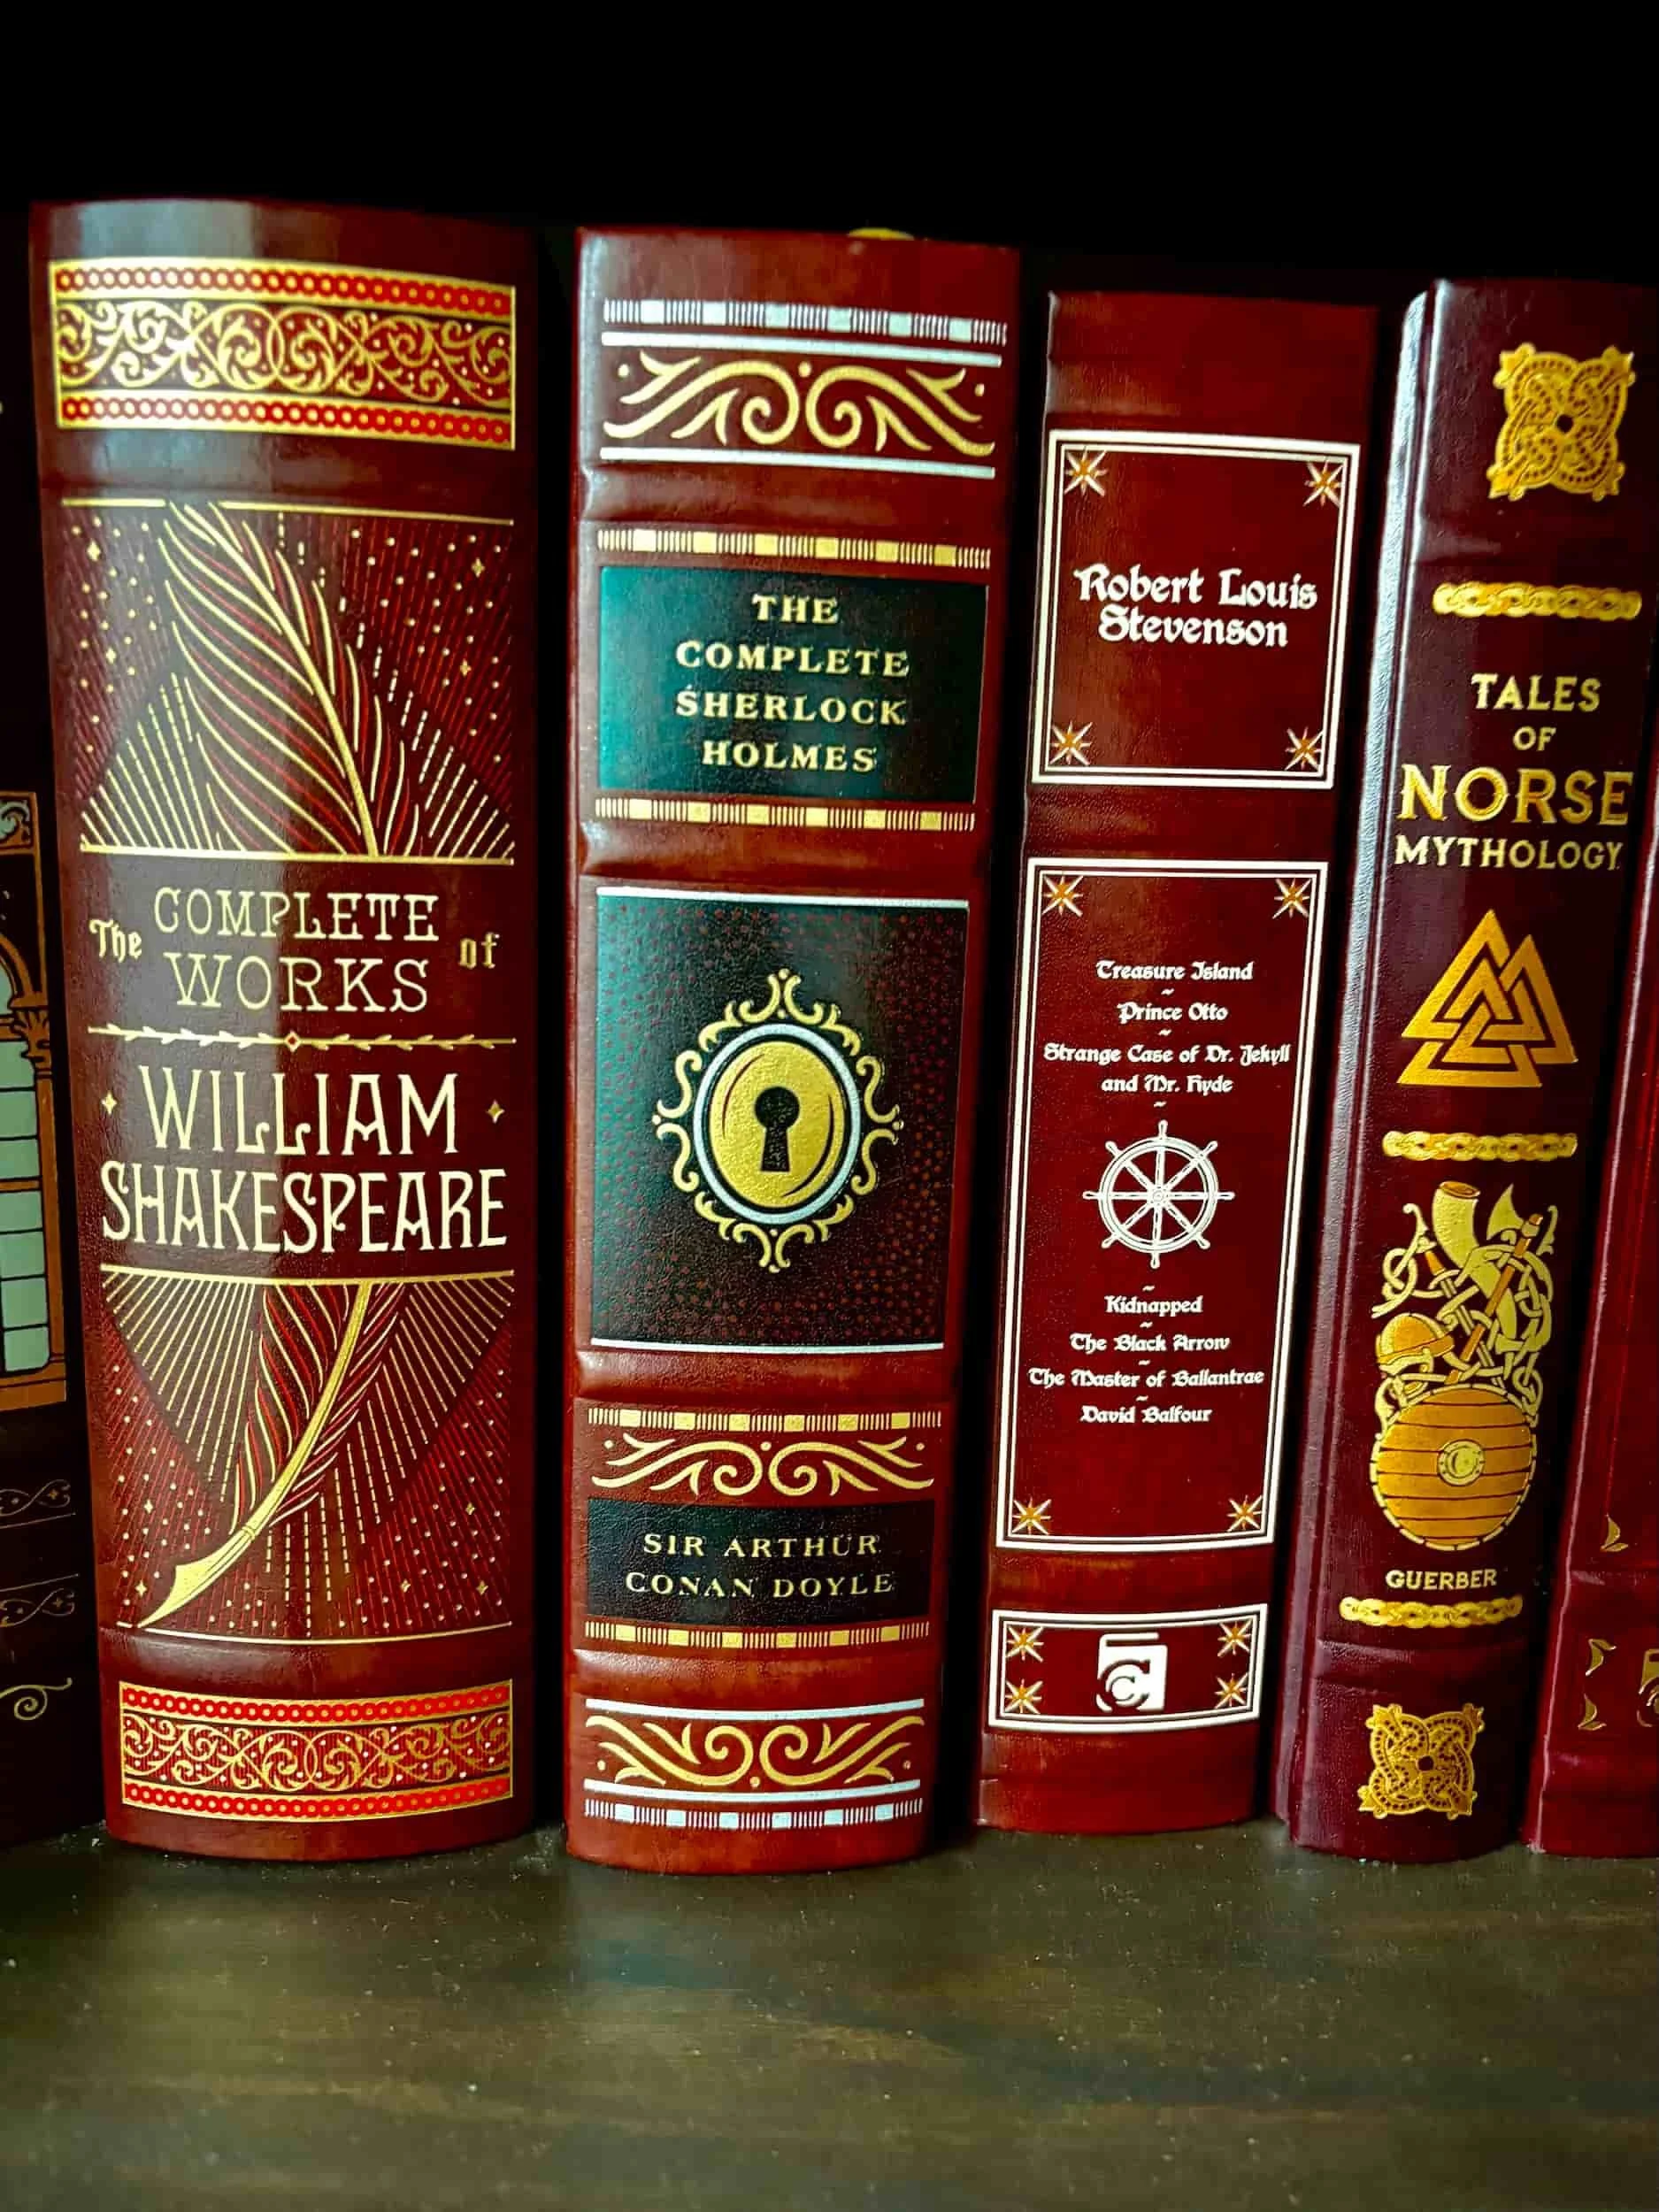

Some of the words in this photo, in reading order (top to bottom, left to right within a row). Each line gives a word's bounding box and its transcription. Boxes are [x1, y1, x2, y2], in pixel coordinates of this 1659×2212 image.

[1073, 563, 1204, 604] Robert
[1218, 568, 1317, 610] Louis
[751, 594, 840, 624] THE
[1098, 603, 1288, 648] Stevenson
[675, 640, 910, 678] COMPLETE
[675, 689, 908, 726] SHERLOCK
[1471, 672, 1601, 712] TALES
[1513, 726, 1557, 751] OF
[702, 740, 879, 773] HOLMES
[1396, 764, 1634, 826] NORSE
[1394, 835, 1624, 871] MYTHOLOGY
[154, 887, 440, 941] COMPLETE
[89, 919, 142, 963] The
[459, 933, 500, 969] of
[163, 952, 429, 1013] WORKS
[1095, 960, 1185, 979] Treasure
[1190, 961, 1255, 980] Island
[1117, 1002, 1183, 1024] Prince
[1187, 1002, 1229, 1021] Otto
[1043, 1042, 1122, 1065] Strange
[1126, 1044, 1174, 1063] Case
[1179, 1045, 1200, 1063] of
[1204, 1045, 1234, 1063] Dr.
[1239, 1044, 1292, 1066] Jekyll
[1101, 1074, 1139, 1093] and
[1144, 1075, 1180, 1093] Mr.
[1186, 1074, 1234, 1096] Hyde
[139, 1065, 458, 1156] WILLIAM
[100, 1160, 507, 1254] SHAKESPEARE
[1104, 1295, 1203, 1317] Kidnapped
[1069, 1333, 1108, 1354] The
[1113, 1334, 1167, 1352] Black
[1172, 1334, 1231, 1352] Arrow
[1028, 1368, 1065, 1389] The
[1071, 1369, 1141, 1387] Master
[1145, 1371, 1166, 1387] of
[1171, 1369, 1265, 1387] Ballantrae
[1079, 1405, 1136, 1424] David
[1141, 1405, 1213, 1423] Balfour
[643, 1533, 705, 1557] SIR
[723, 1534, 881, 1558] ARTHUR
[625, 1571, 757, 1598] CONAN
[773, 1573, 895, 1598] DOYLE
[1386, 1569, 1497, 1590] GUERBER
